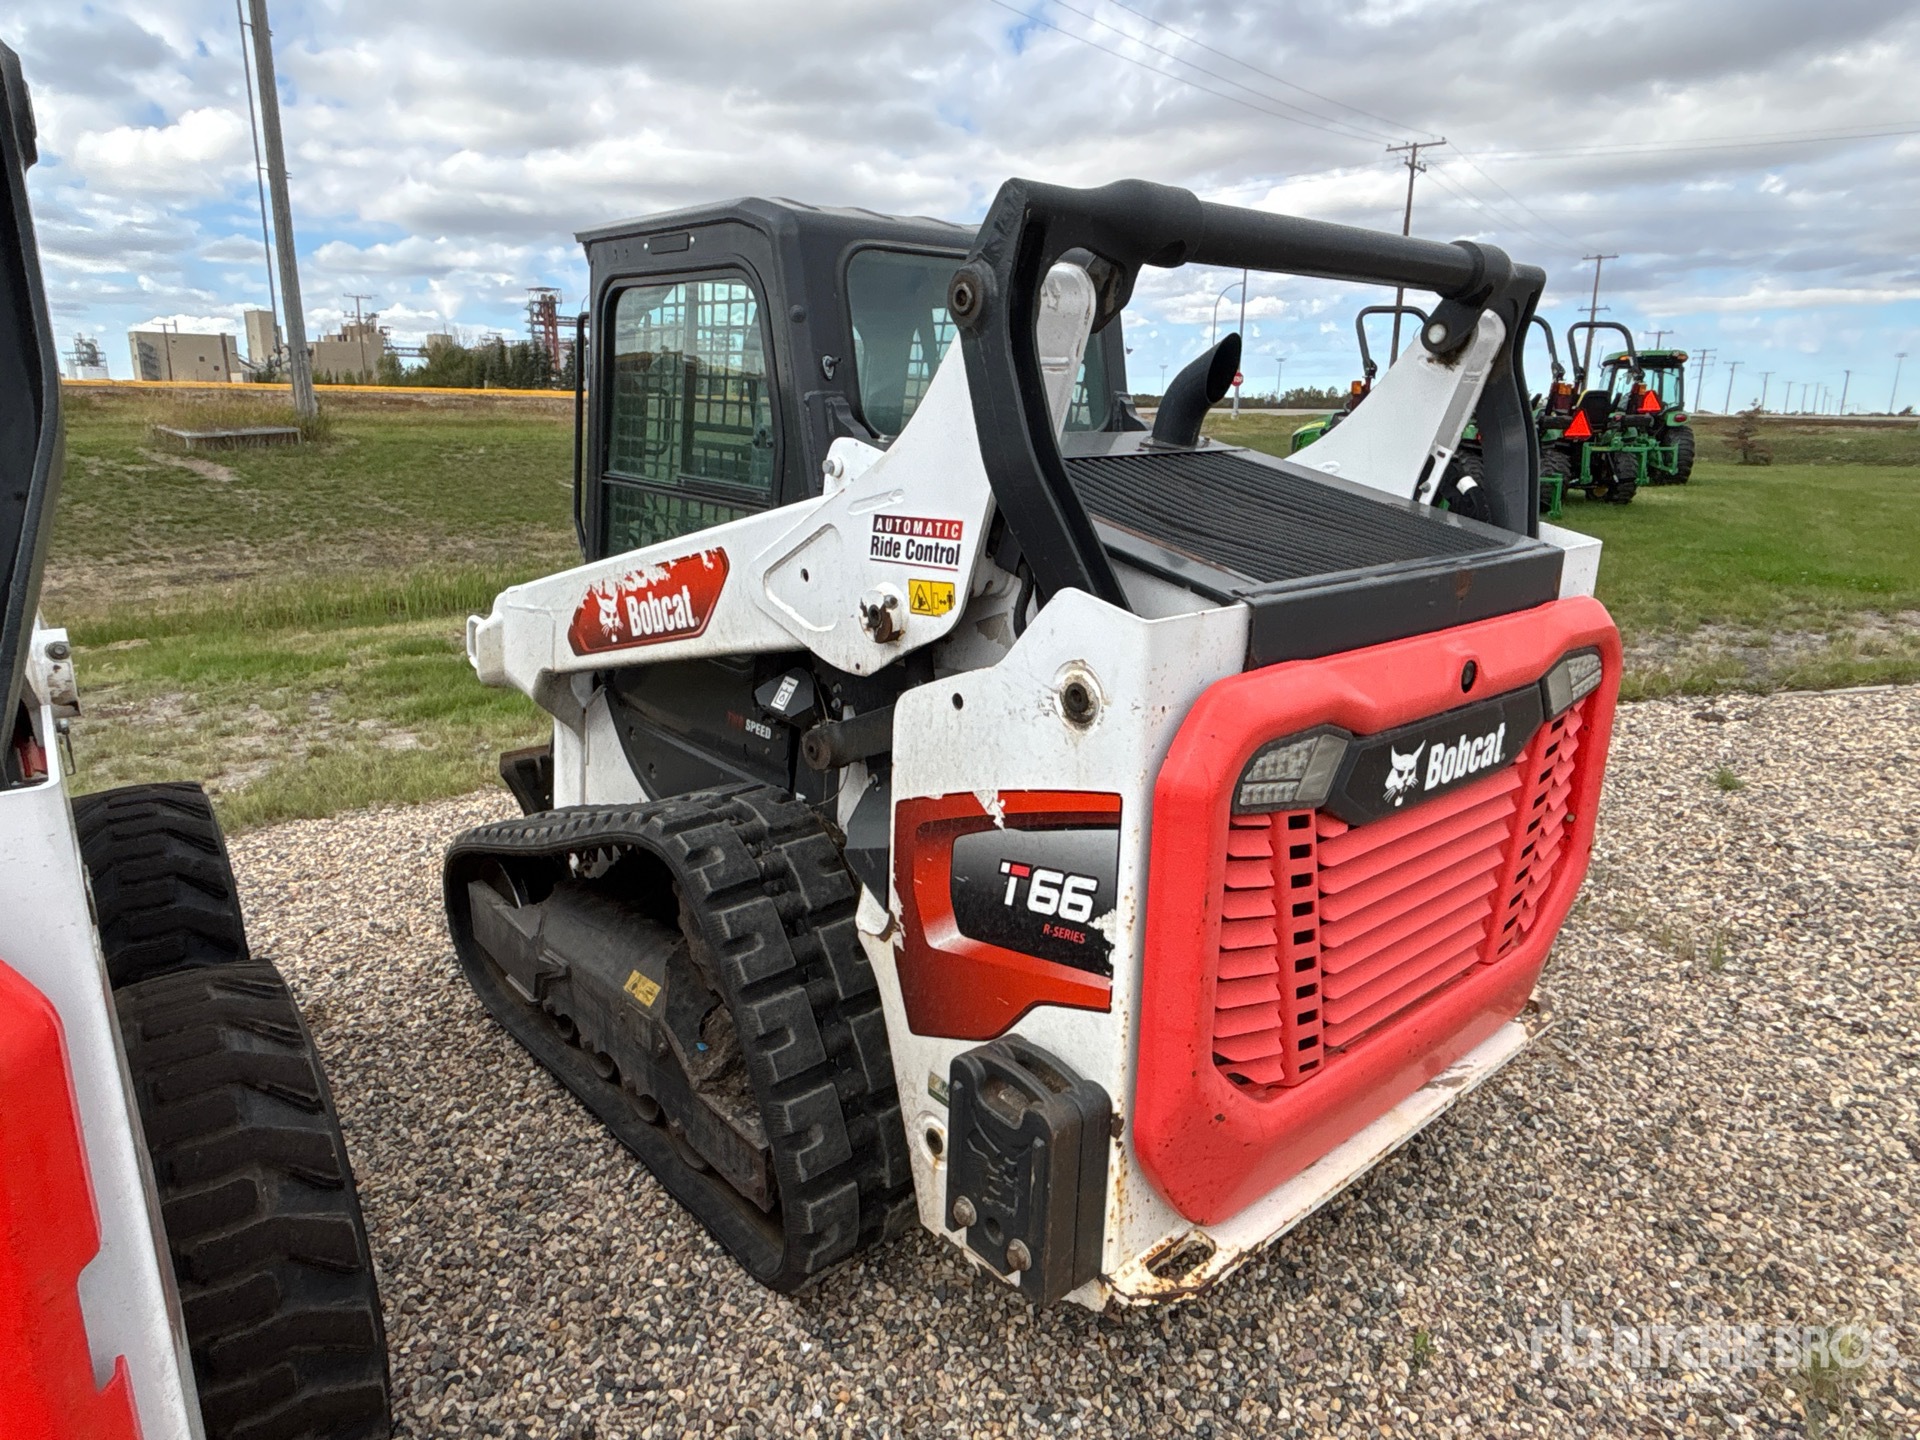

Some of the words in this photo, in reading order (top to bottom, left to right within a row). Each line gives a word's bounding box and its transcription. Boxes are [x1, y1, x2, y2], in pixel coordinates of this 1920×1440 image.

[875, 517, 960, 539] AUTOMATIC
[870, 535, 901, 558] Ride
[905, 538, 961, 565] Control
[625, 585, 695, 637] Bobcat
[745, 718, 772, 740] SPEED
[1424, 722, 1506, 791] Bobcat
[998, 860, 1098, 923] T66
[1042, 923, 1087, 945] R-SERIES
